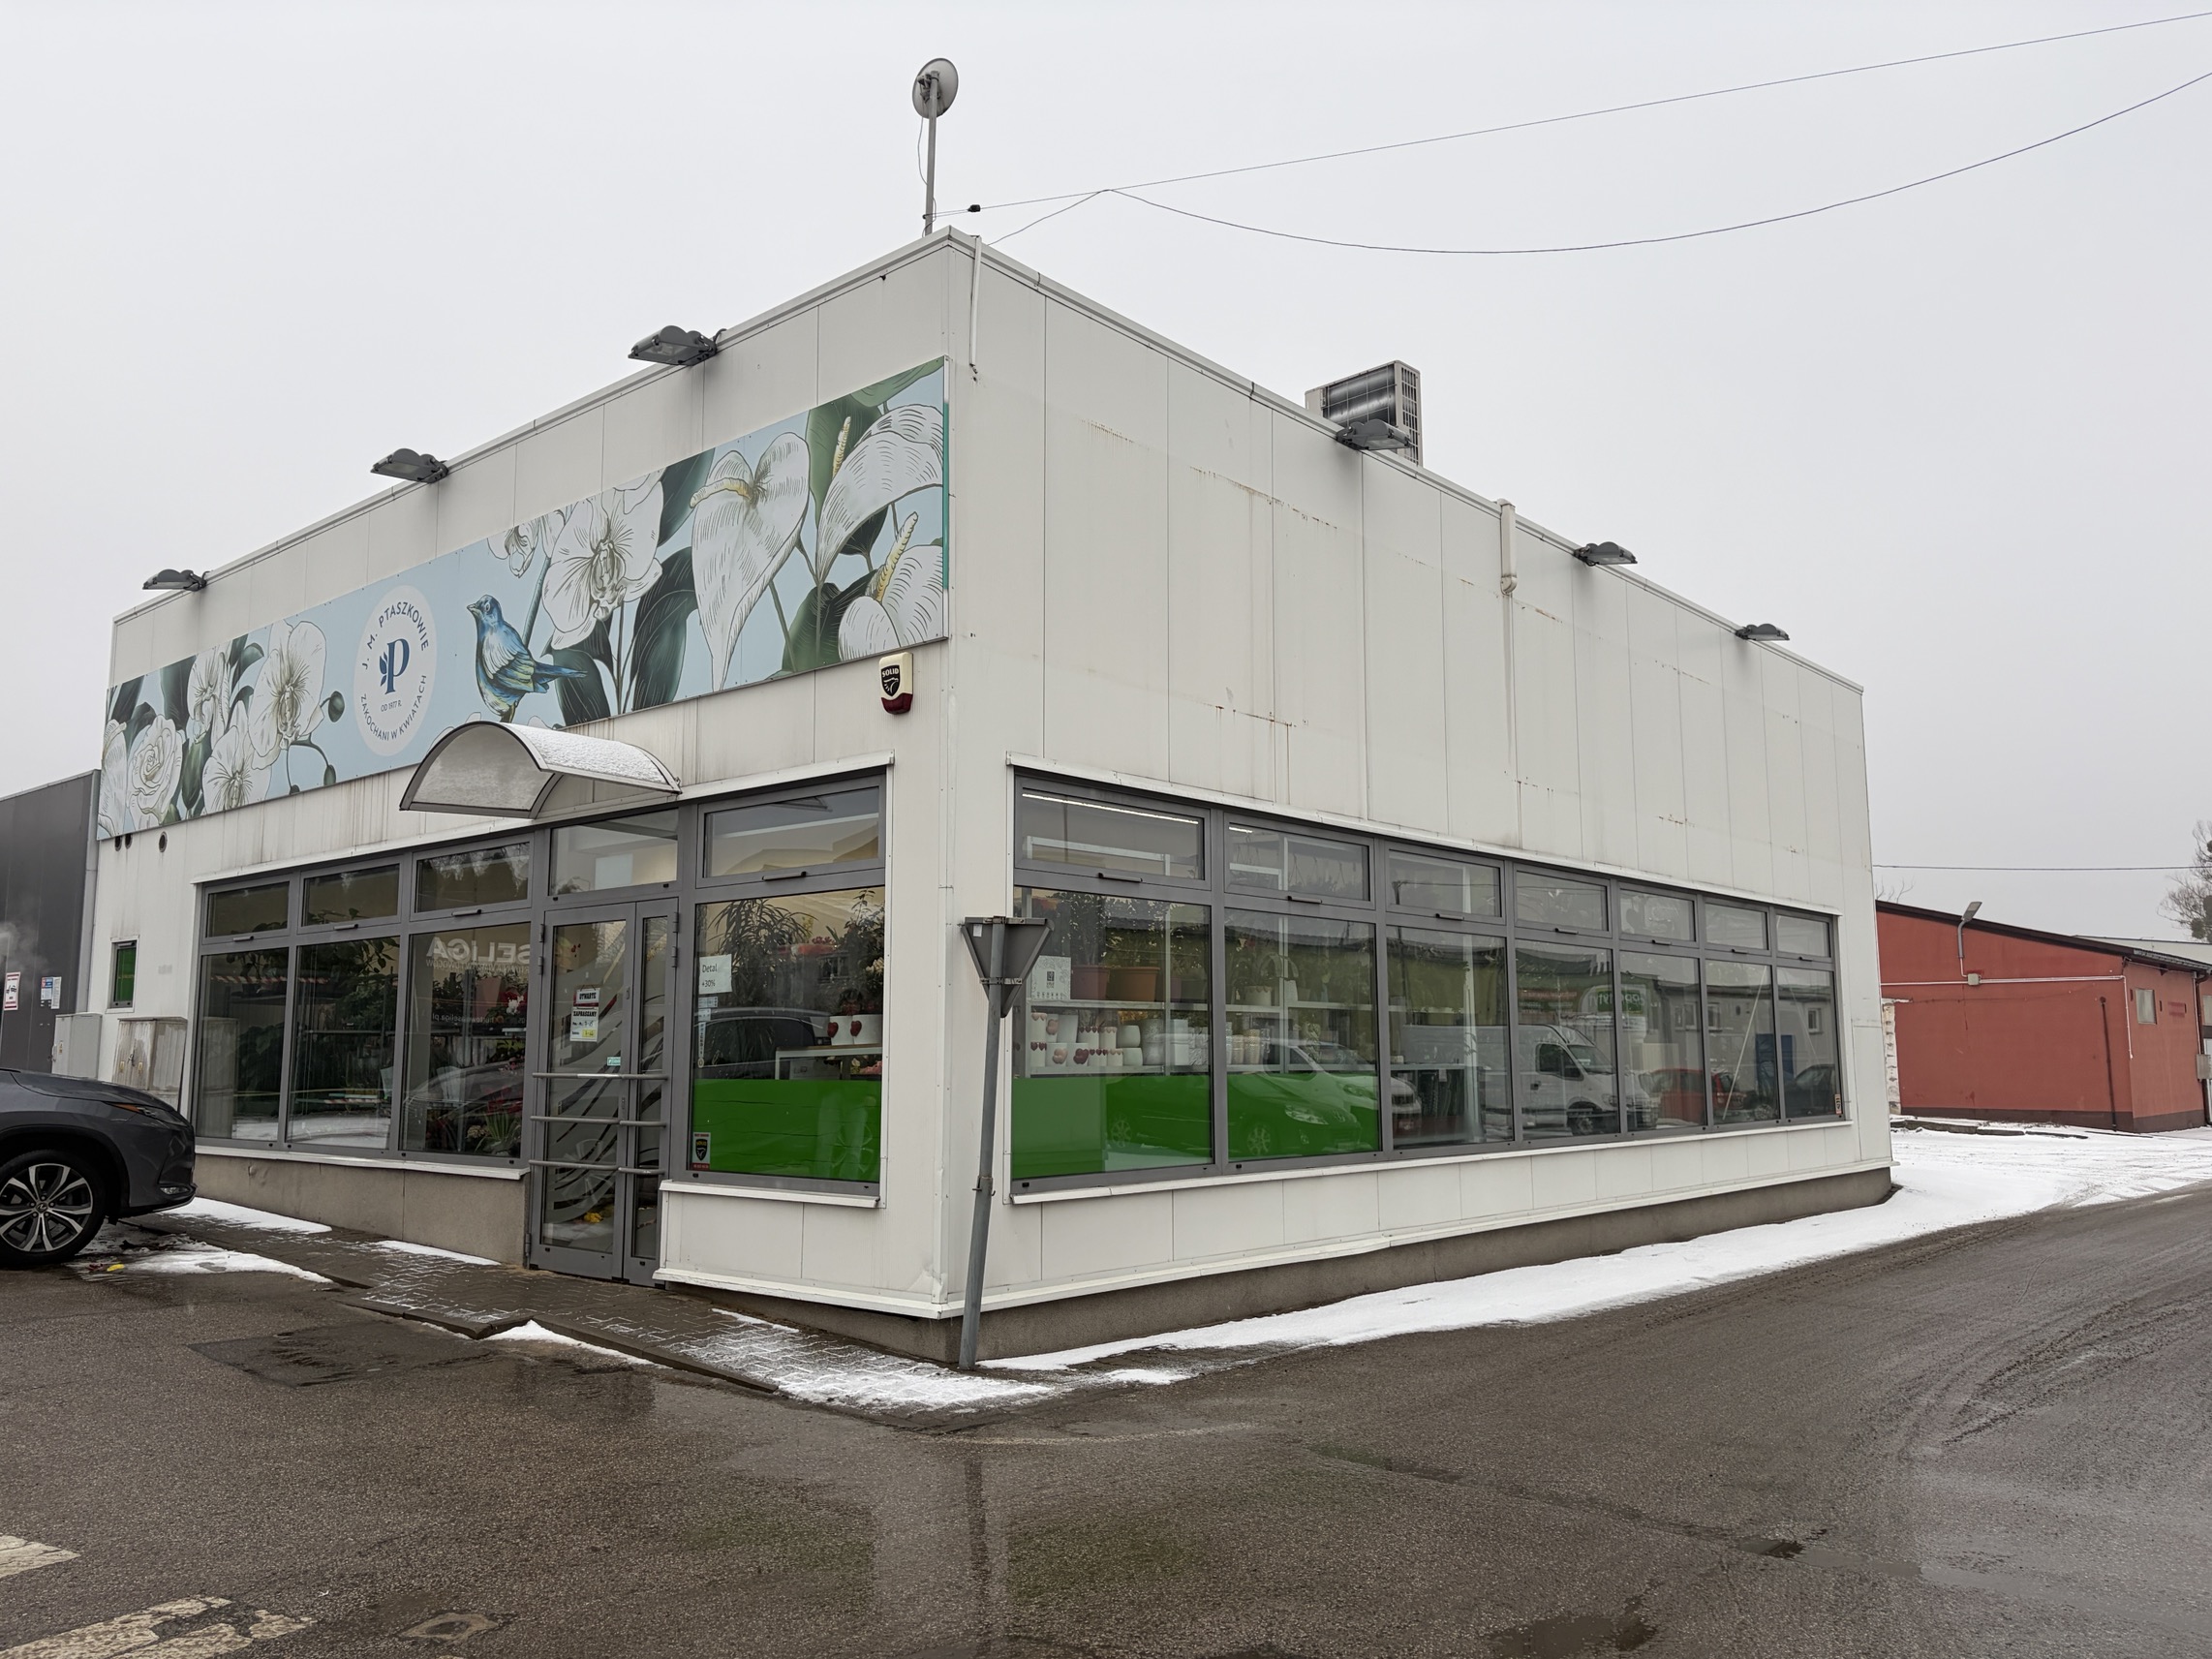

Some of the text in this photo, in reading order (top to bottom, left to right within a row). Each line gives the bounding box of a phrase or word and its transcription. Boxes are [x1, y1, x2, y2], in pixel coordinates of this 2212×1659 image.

[362, 601, 429, 670] J. M. PTASZKOWIE
[881, 667, 900, 678] SOLID
[360, 674, 427, 741] ZAKOCHANI W KWIATACH
[380, 703, 388, 712] OD
[702, 964, 718, 973] Detal
[701, 979, 716, 988] +30%
